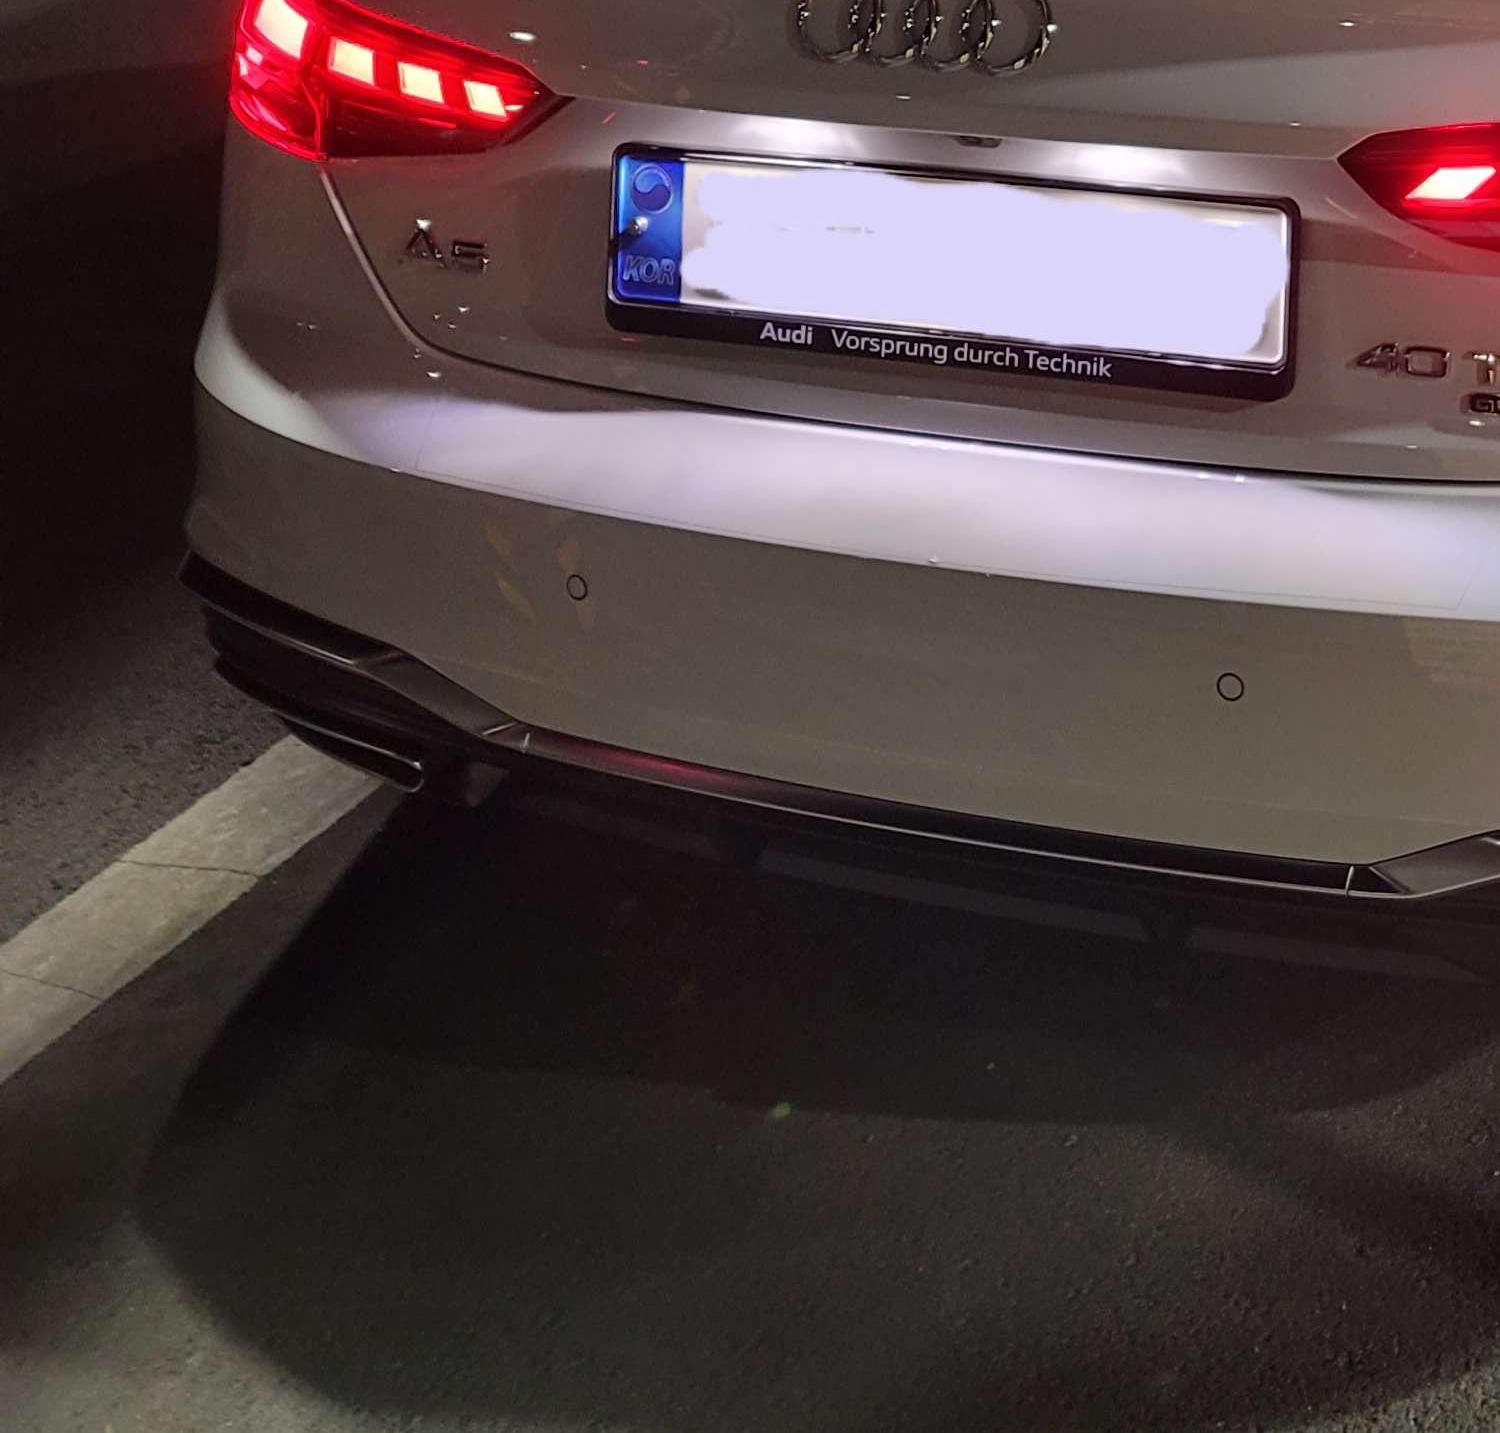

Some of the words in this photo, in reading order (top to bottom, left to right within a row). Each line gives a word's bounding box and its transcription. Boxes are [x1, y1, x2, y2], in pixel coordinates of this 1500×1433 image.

[403, 218, 490, 274] A5
[622, 255, 676, 286] KOR
[760, 321, 813, 345] Audi
[831, 329, 948, 365] Vorsprung
[953, 342, 1019, 368] durch
[1024, 349, 1112, 378] Technik
[1347, 341, 1451, 379] 40
